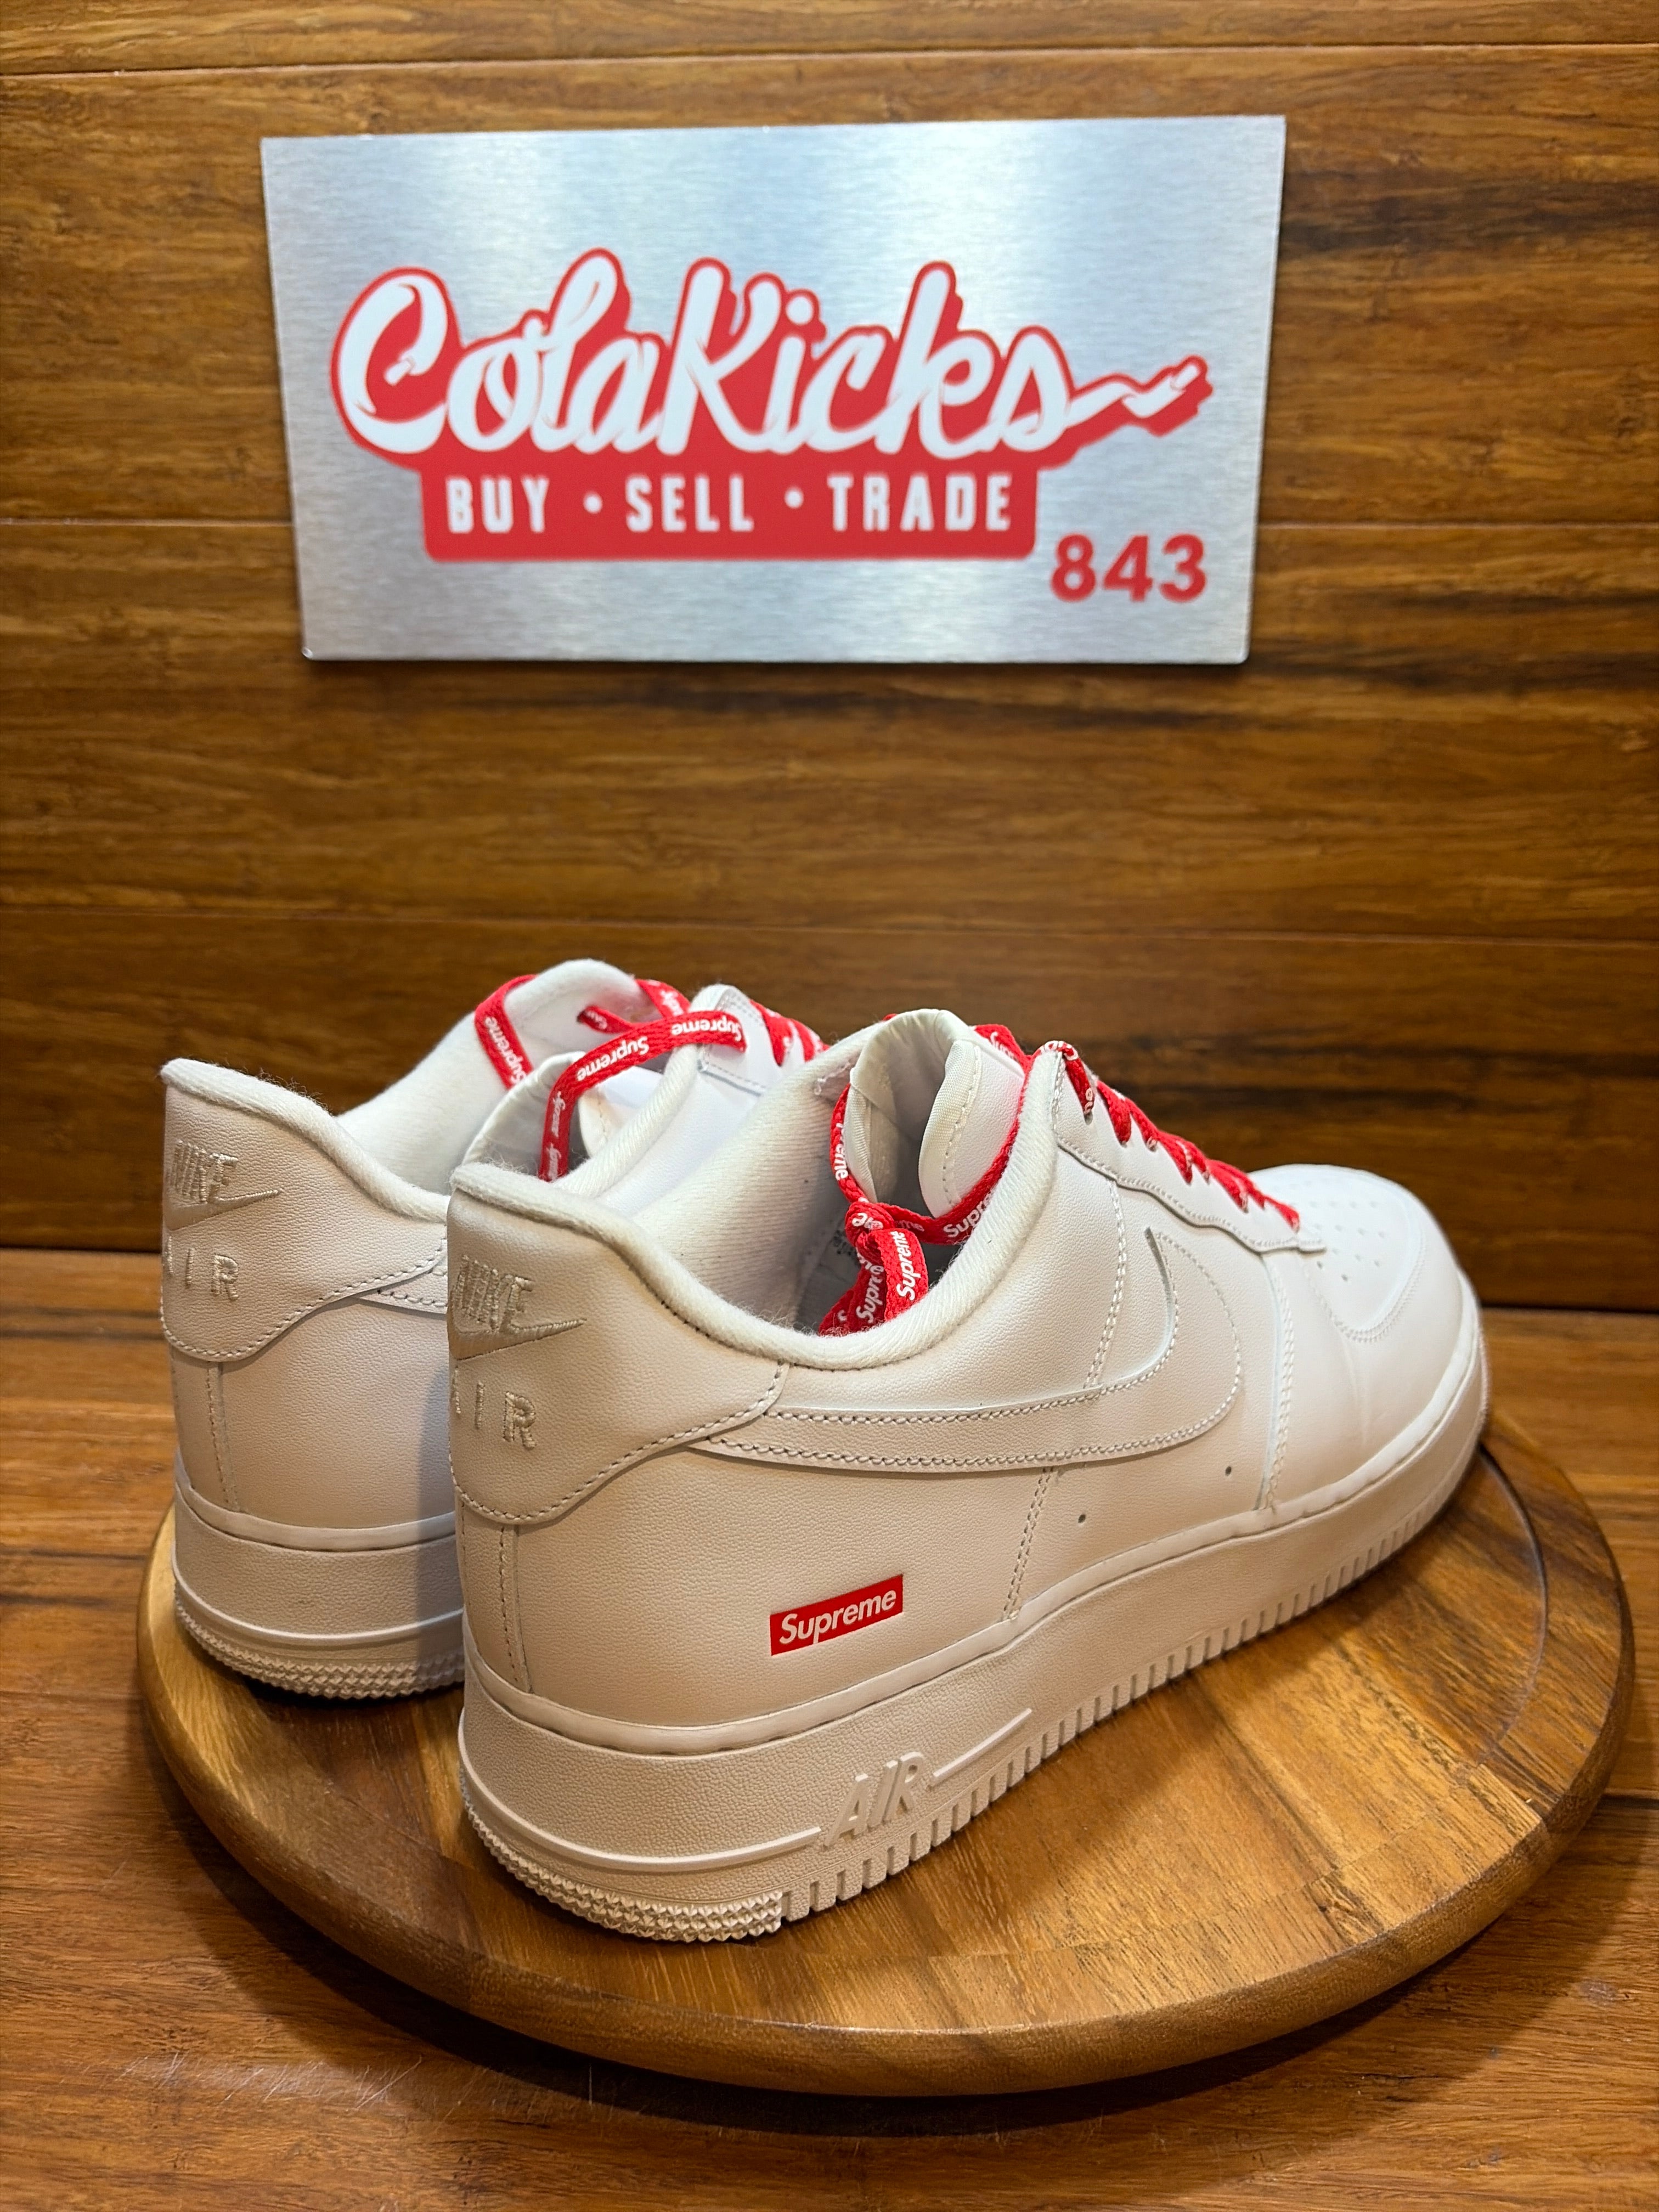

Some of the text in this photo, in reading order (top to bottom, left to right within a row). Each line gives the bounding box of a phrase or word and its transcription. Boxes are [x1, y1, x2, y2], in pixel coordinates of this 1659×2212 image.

[445, 472, 1012, 533] BUY SELL TRADE
[1050, 533, 1206, 602] 843
[485, 1016, 527, 1084] Supreme
[576, 1035, 650, 1081] Supreme
[671, 1015, 742, 1042] Supreme
[890, 1231, 921, 1301] Supreme
[778, 1589, 897, 1645] Supreme
[822, 1751, 927, 1849] AIR
